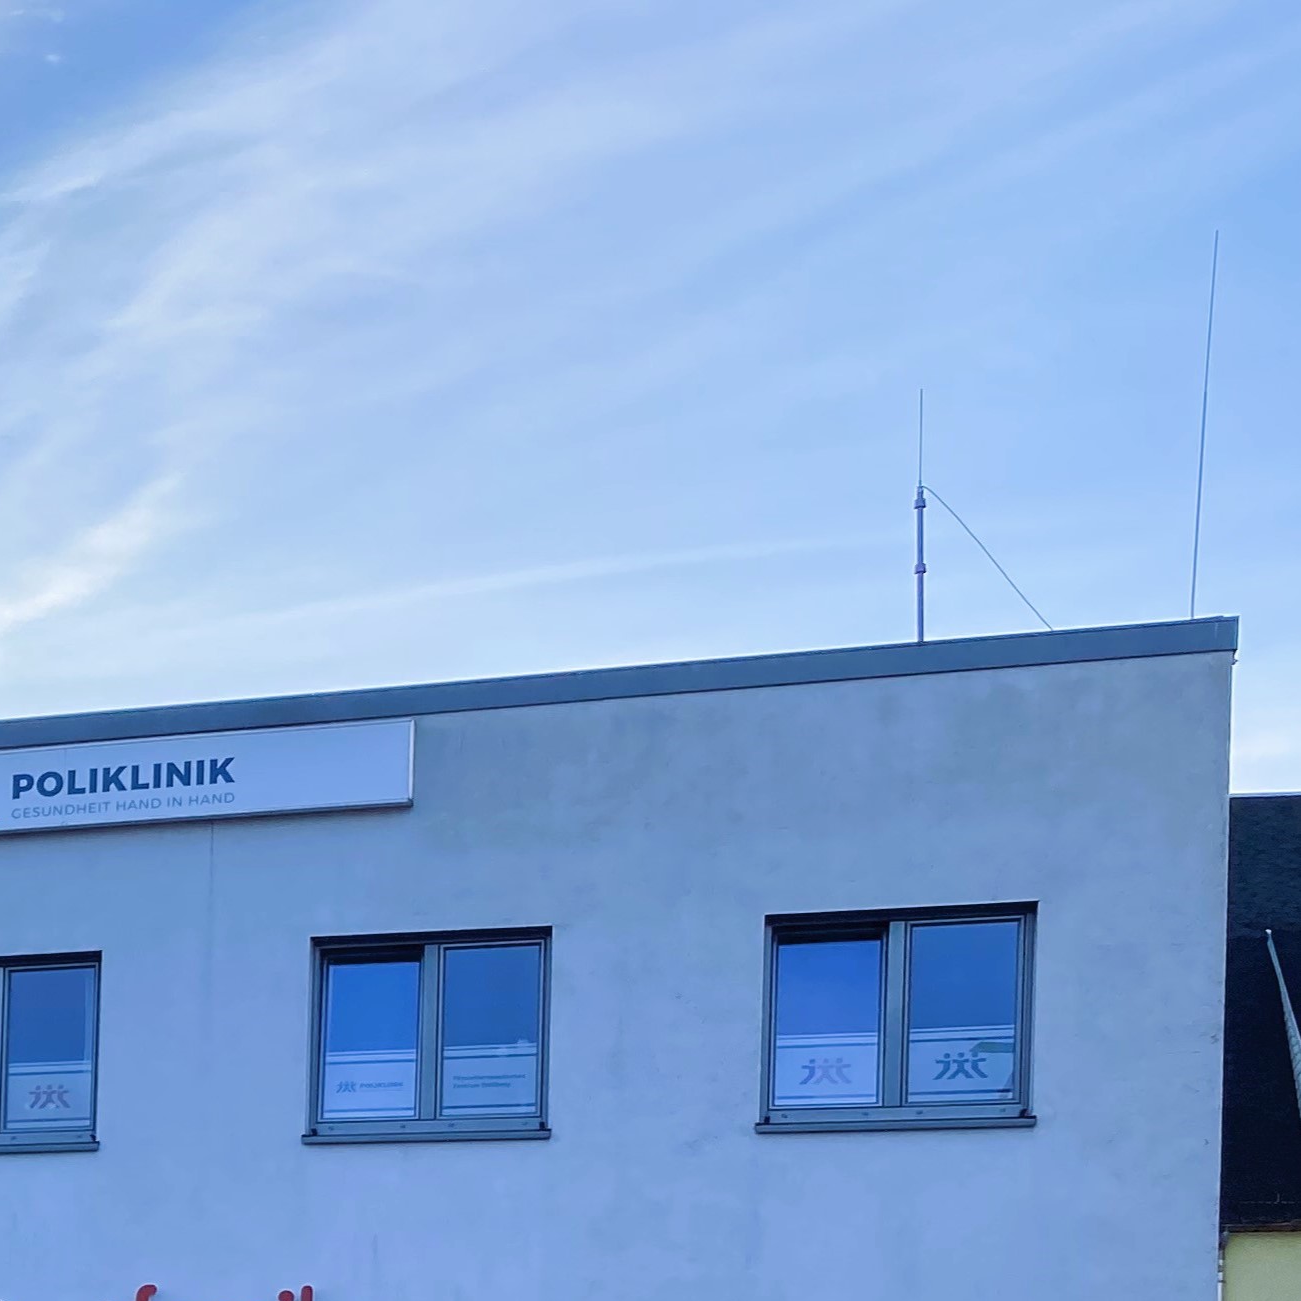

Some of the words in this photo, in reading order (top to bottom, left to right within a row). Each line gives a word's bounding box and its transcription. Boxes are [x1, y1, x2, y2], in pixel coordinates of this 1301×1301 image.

[12, 757, 236, 800] POLIKLINIK
[10, 801, 112, 820] GESUNDHEIT
[115, 798, 162, 812] HAND
[166, 796, 183, 807] IN
[188, 792, 236, 805] HAND
